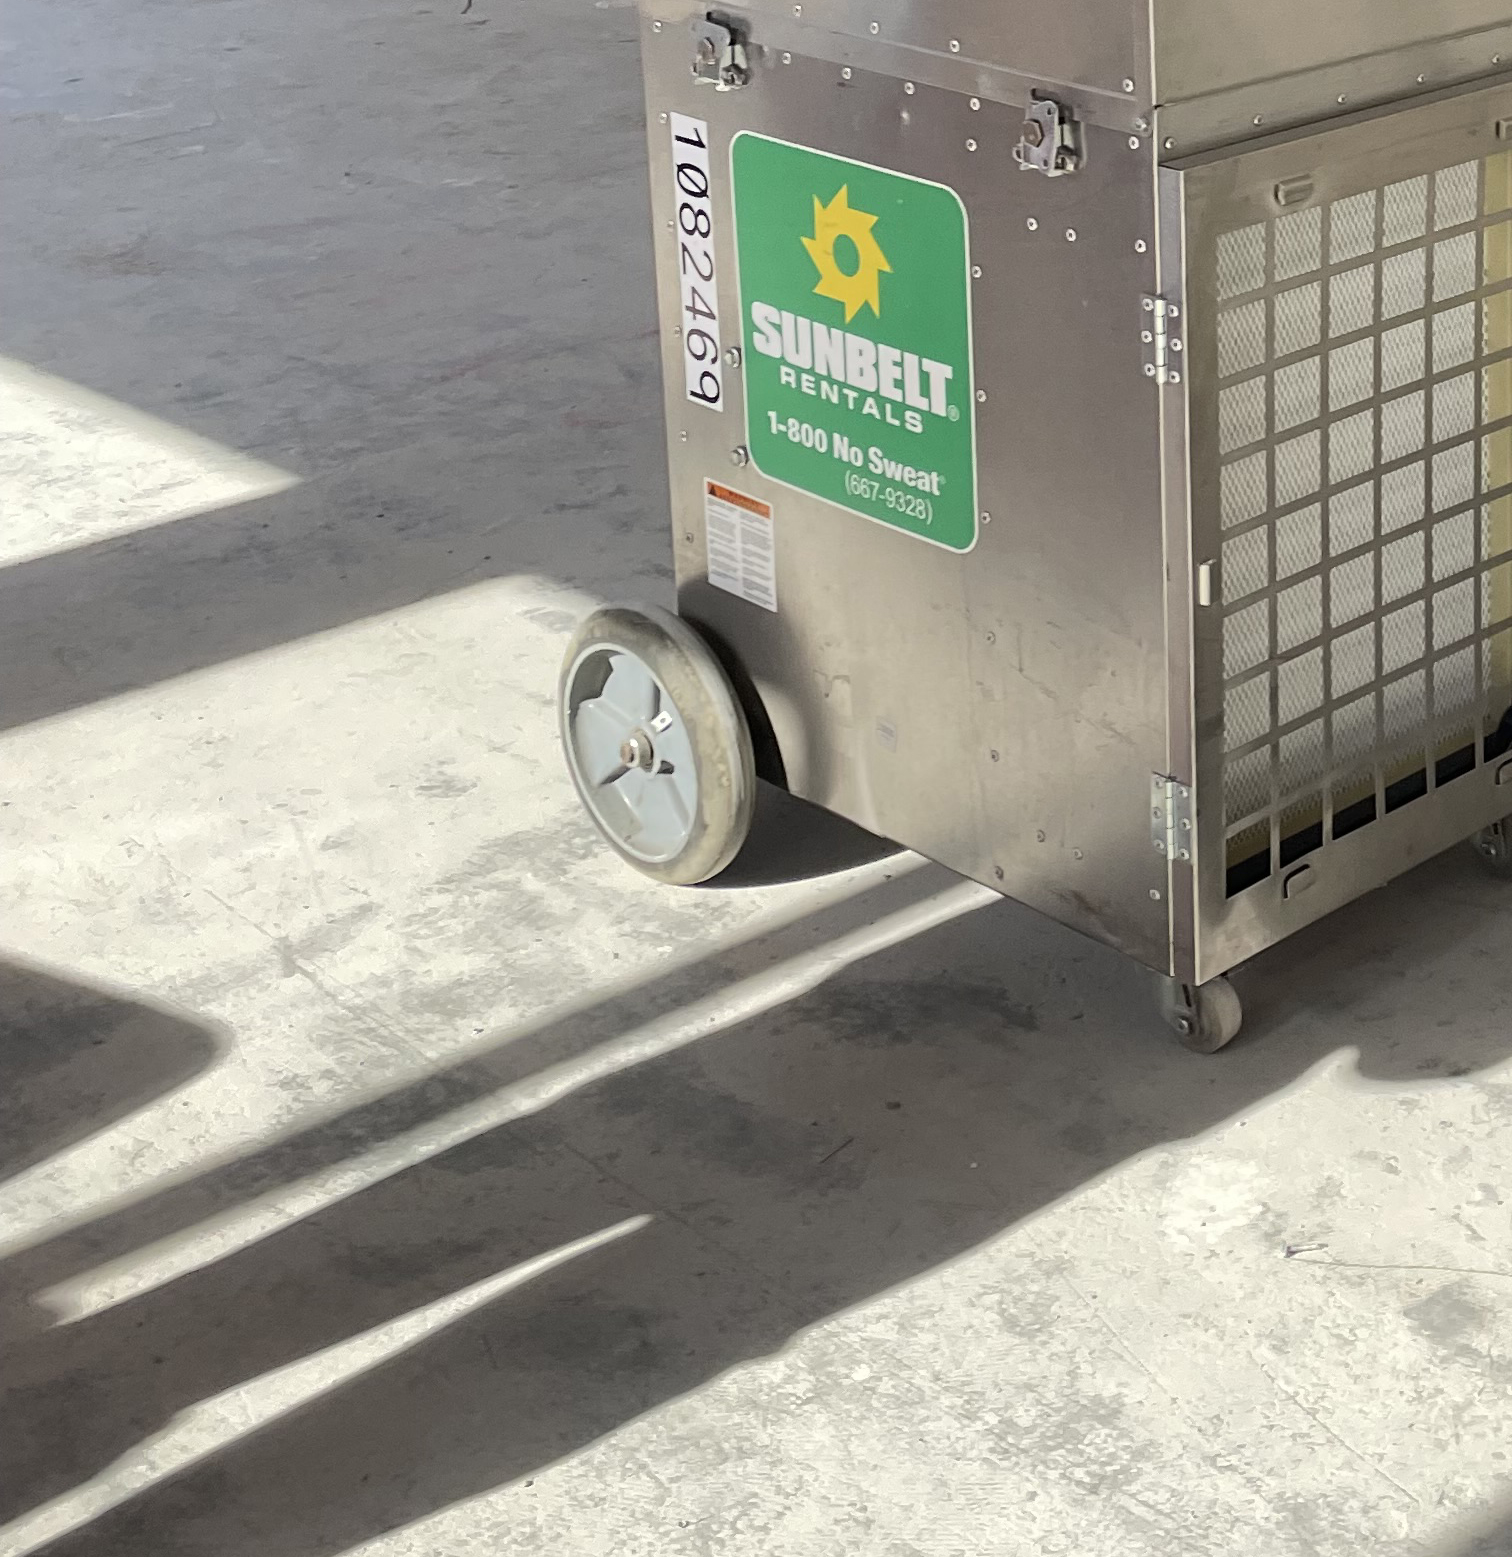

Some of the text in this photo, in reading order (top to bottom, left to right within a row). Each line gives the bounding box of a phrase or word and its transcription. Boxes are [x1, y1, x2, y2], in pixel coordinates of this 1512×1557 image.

[674, 127, 721, 404] 1082469
[751, 300, 954, 418] SUNBELT
[779, 364, 924, 434] RENTALS
[767, 410, 942, 497] 1-800 No Sweat
[844, 469, 934, 526] (667-9328)
